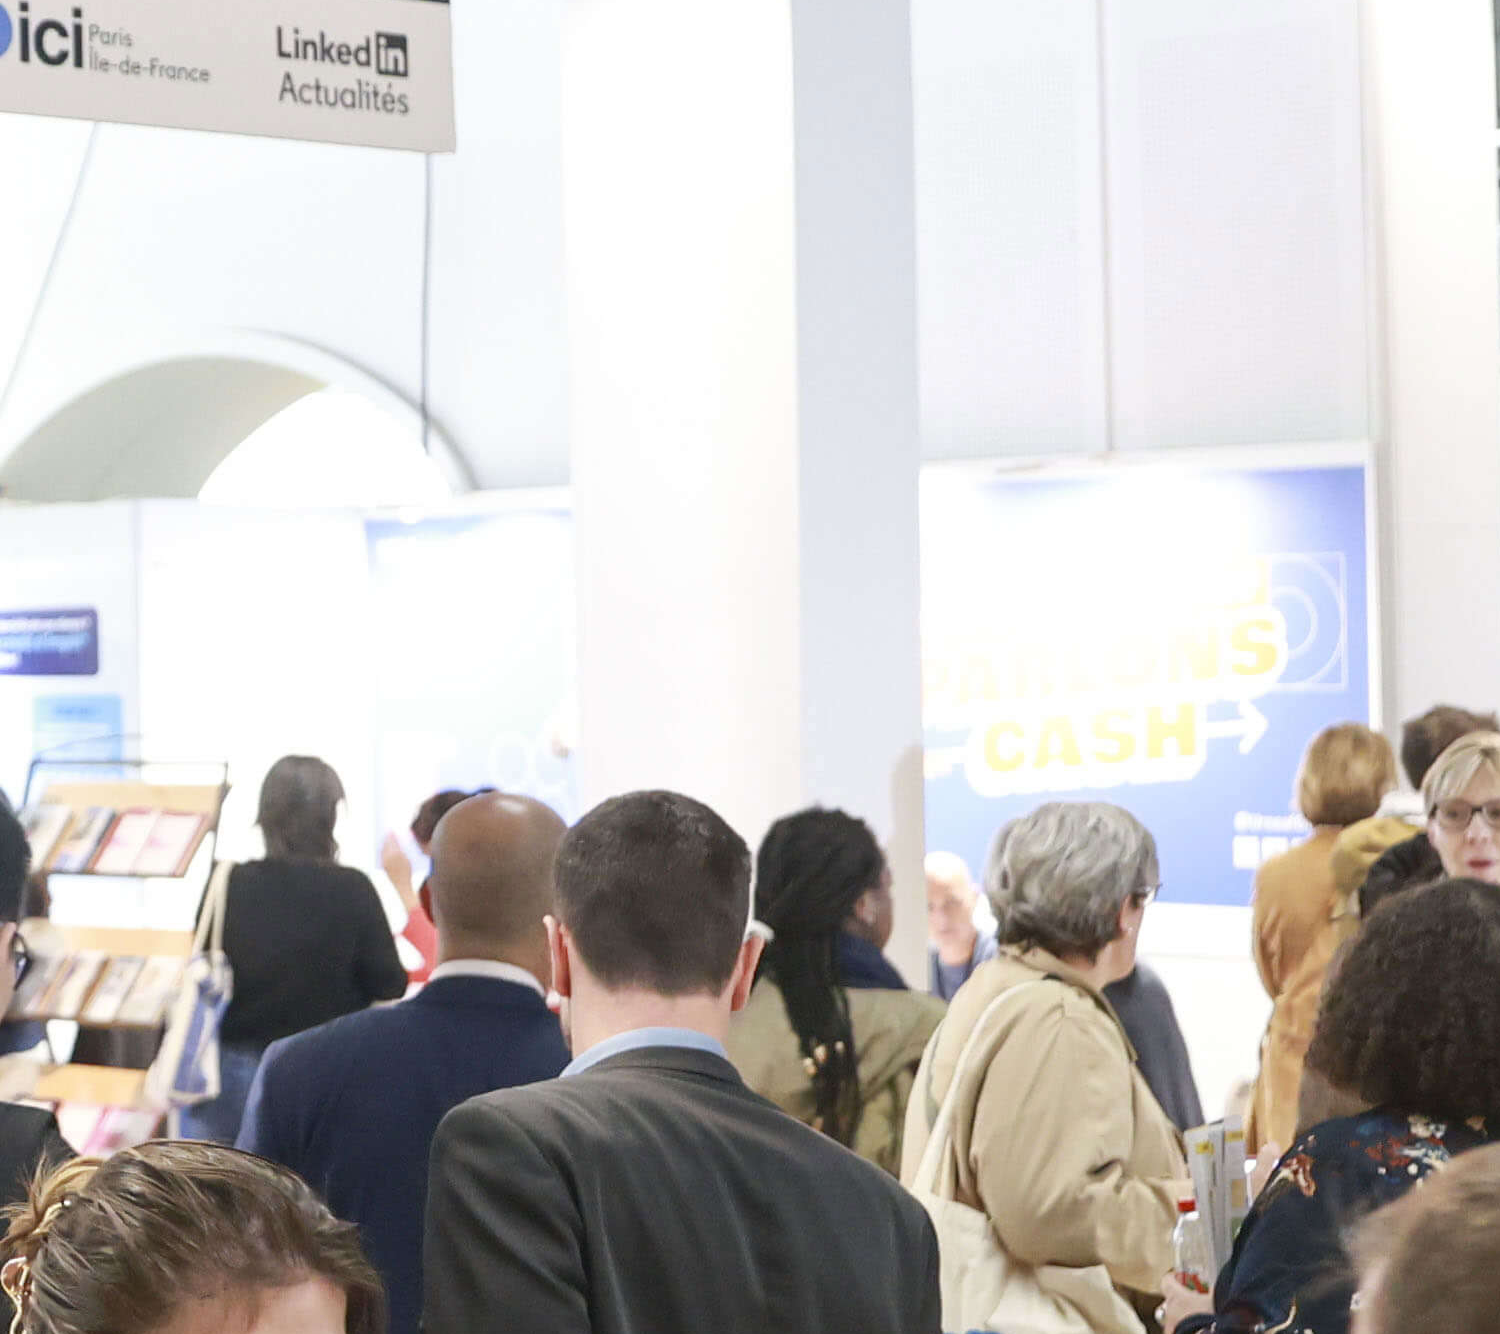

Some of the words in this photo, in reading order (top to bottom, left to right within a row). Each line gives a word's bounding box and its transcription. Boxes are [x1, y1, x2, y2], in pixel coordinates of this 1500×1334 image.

[18, 1, 83, 68] ici
[88, 24, 133, 48] Paris
[279, 72, 408, 115] Actualités
[983, 702, 1197, 772] CASH
